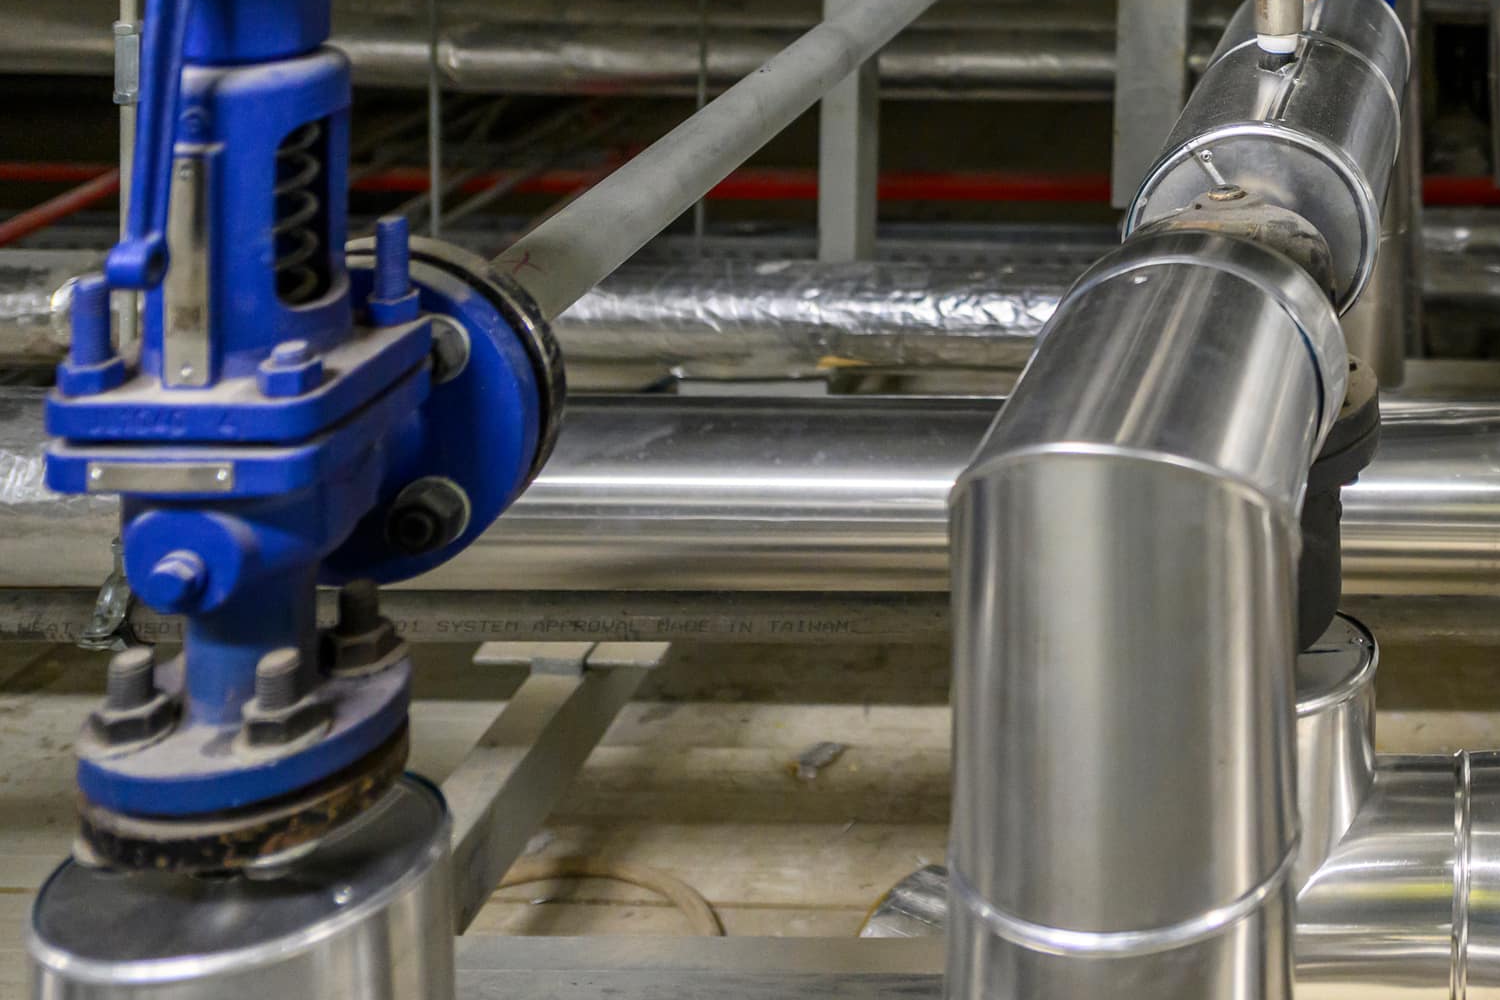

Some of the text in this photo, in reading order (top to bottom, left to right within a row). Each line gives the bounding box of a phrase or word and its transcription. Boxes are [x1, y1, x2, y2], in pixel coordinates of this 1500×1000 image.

[436, 619, 518, 633] SYSTEM
[531, 619, 634, 633] APPROVAL
[656, 618, 711, 633] MADE
[730, 620, 753, 633] IN
